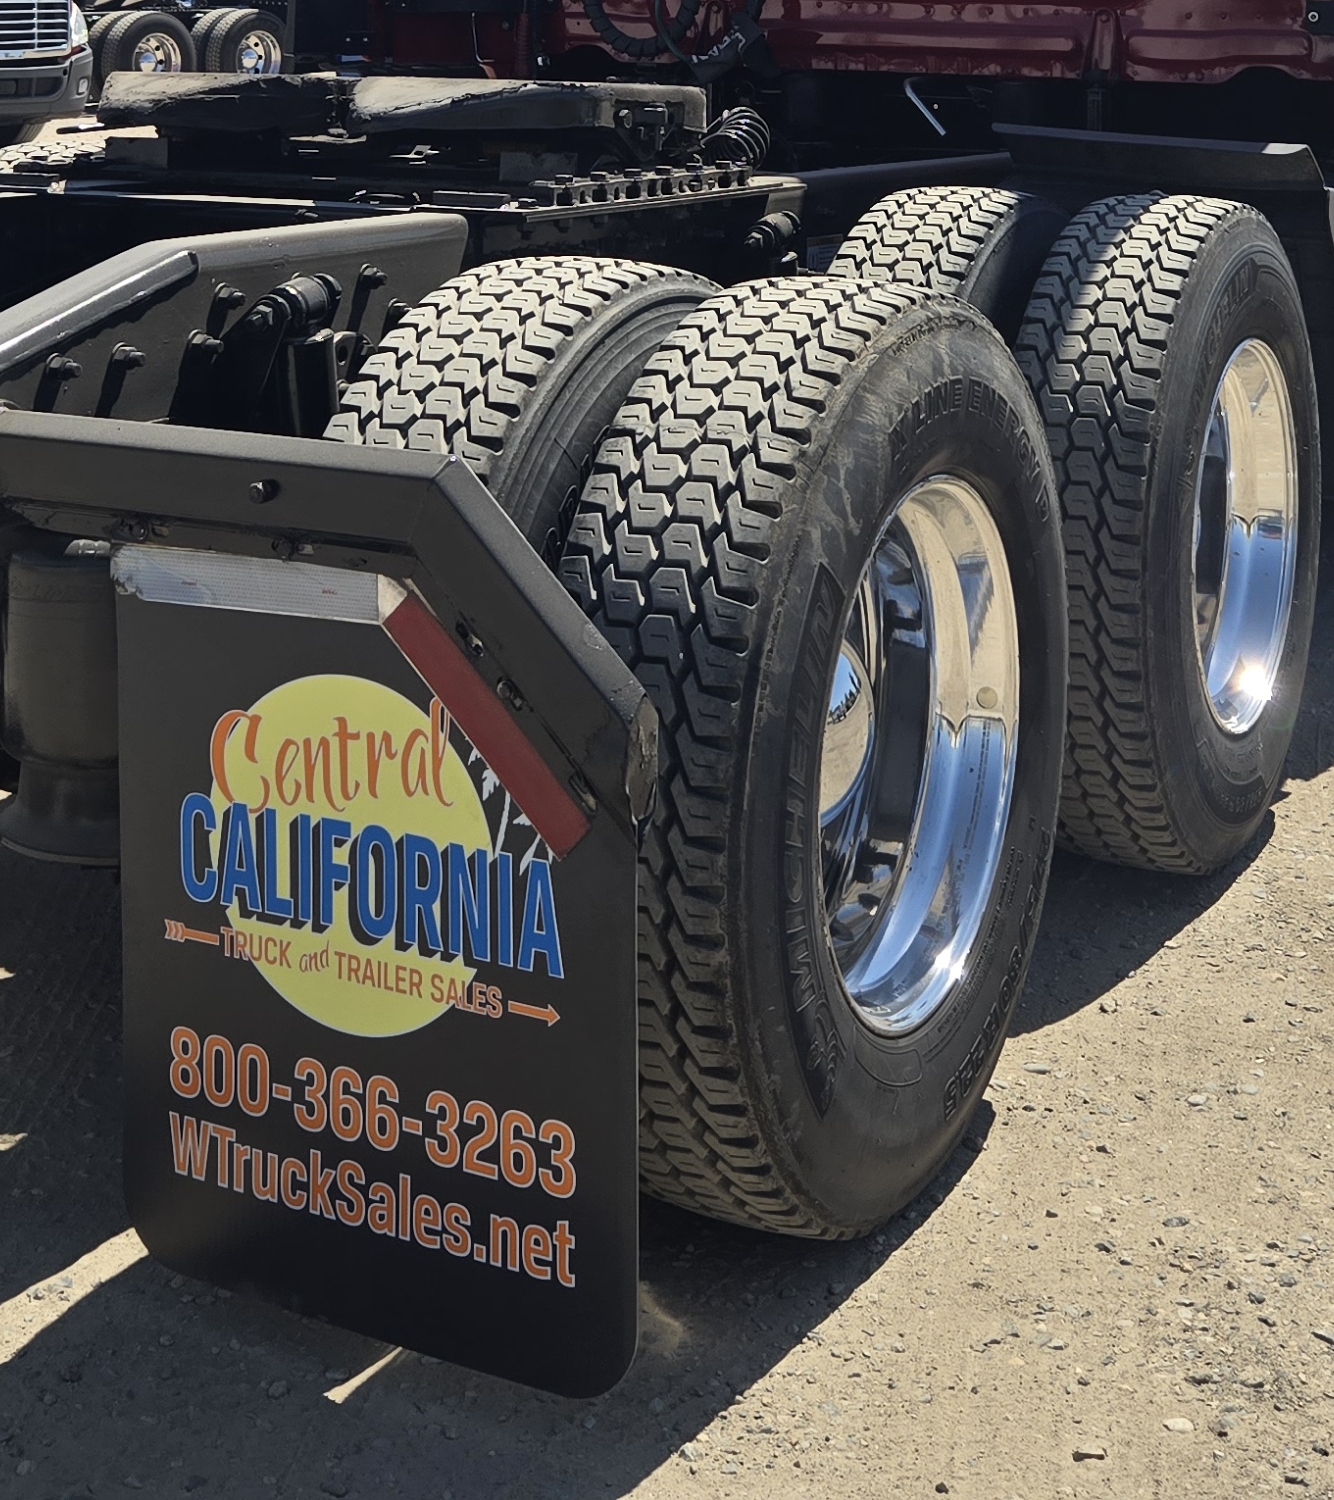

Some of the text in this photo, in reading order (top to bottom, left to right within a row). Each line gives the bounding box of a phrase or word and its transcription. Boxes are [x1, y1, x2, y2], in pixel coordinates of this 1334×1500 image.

[912, 375, 964, 434] LINE
[968, 375, 1041, 486] ENERGY
[209, 697, 455, 815] Central
[781, 574, 843, 1012] MICHELIN
[179, 792, 566, 981] CALIFORNIA
[219, 924, 504, 1021] TRUCK and TRAILER SALES
[168, 1025, 577, 1200] 800-366-3263
[168, 1109, 577, 1289] WTruckSales.net
